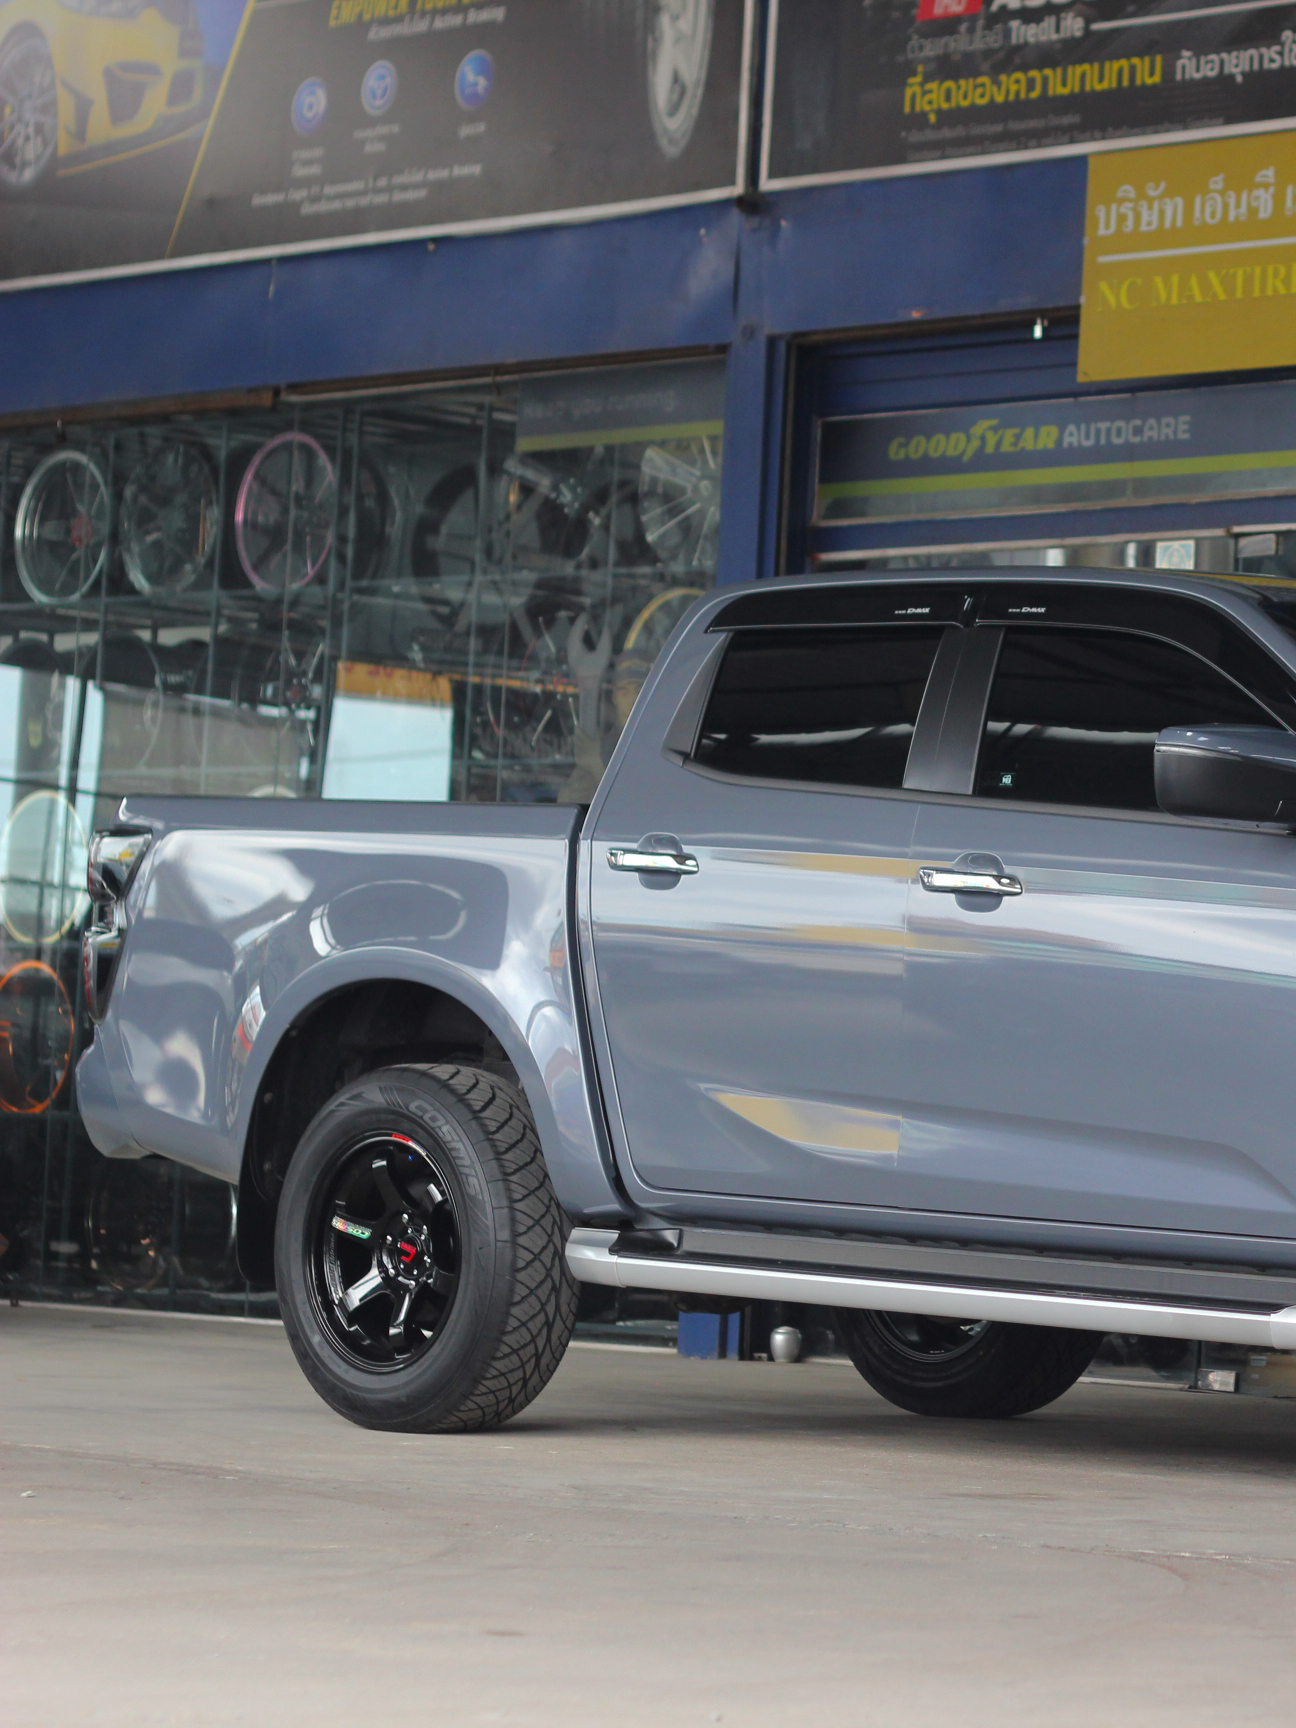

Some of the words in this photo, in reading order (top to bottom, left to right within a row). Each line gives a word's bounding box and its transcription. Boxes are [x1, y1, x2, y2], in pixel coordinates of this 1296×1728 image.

[1009, 12, 1086, 46] TredLife
[903, 54, 1163, 124] ที่สุดของความทนทาน
[1095, 180, 1184, 237] บริษัท
[1193, 165, 1276, 226] เอ็นซี
[1097, 277, 1142, 313] NC
[887, 419, 1060, 463] GOODYEAR
[1062, 414, 1192, 449] AUTOCARE
